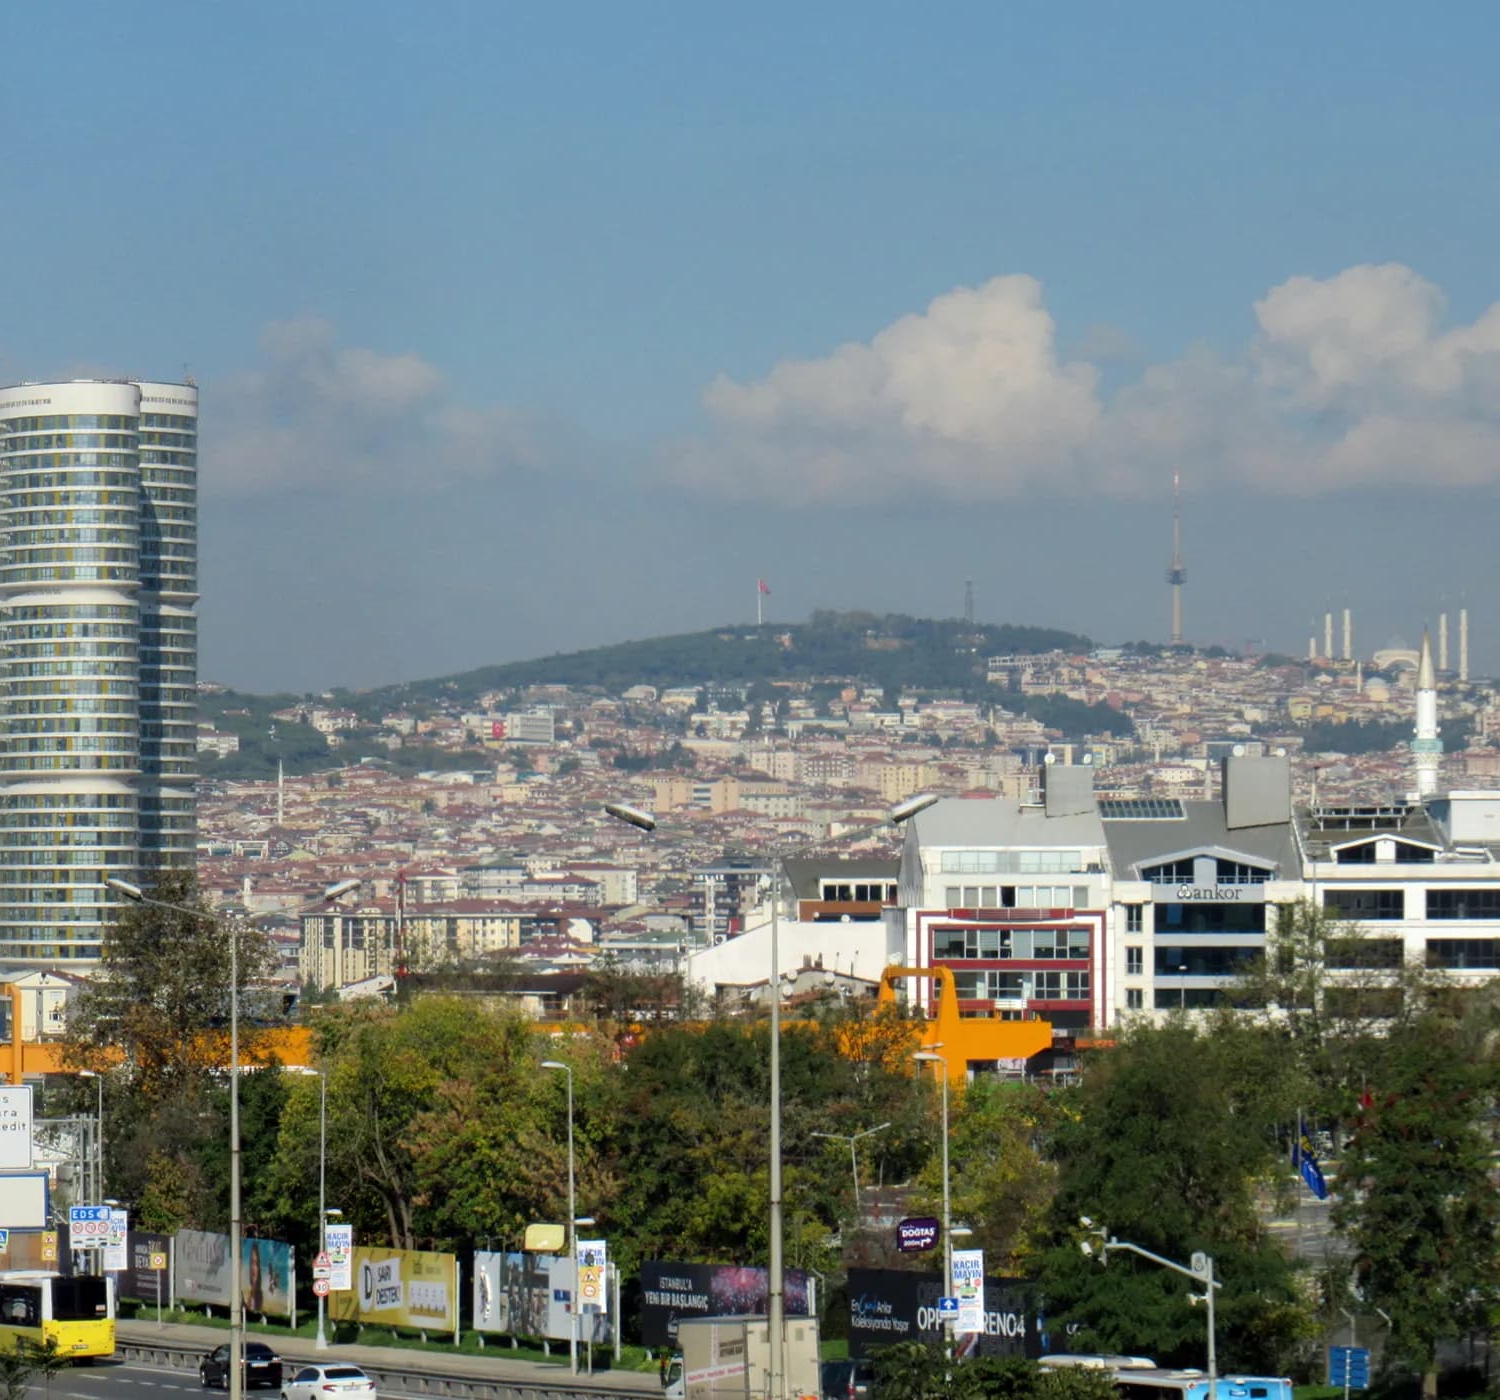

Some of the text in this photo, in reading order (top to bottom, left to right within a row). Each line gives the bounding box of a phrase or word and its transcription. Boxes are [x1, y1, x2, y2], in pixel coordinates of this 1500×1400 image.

[72, 1210, 95, 1219] EDS
[364, 1265, 373, 1300] D
[917, 1306, 941, 1331] OPP
